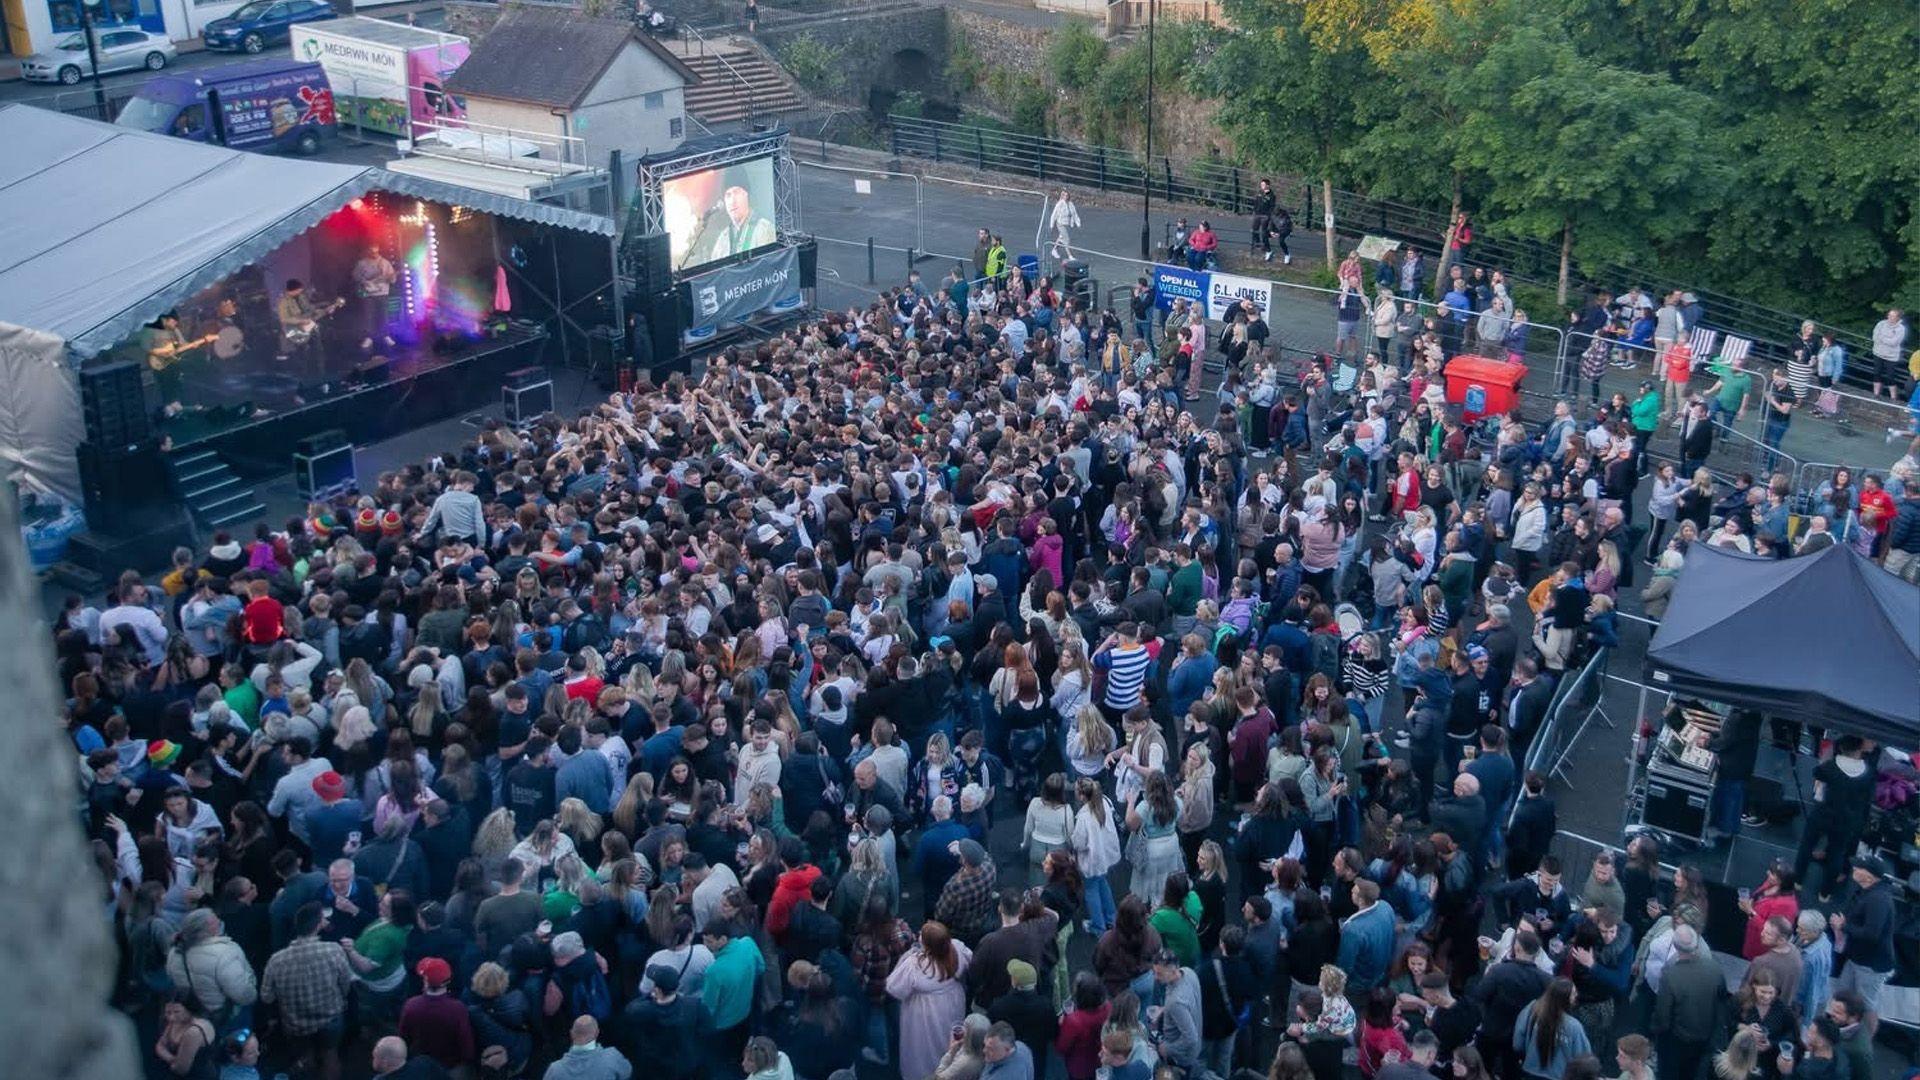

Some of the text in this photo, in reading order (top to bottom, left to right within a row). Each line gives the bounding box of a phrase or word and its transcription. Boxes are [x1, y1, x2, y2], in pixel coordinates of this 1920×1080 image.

[324, 42, 369, 62] MEDRWN
[1160, 274, 1199, 288] OPEN ALL
[724, 279, 762, 302] MENTER
[1158, 282, 1202, 298] WEEKEND
[1214, 283, 1232, 297] C.L.
[1235, 286, 1267, 302] JONES
[1478, 695, 1490, 710] 12
